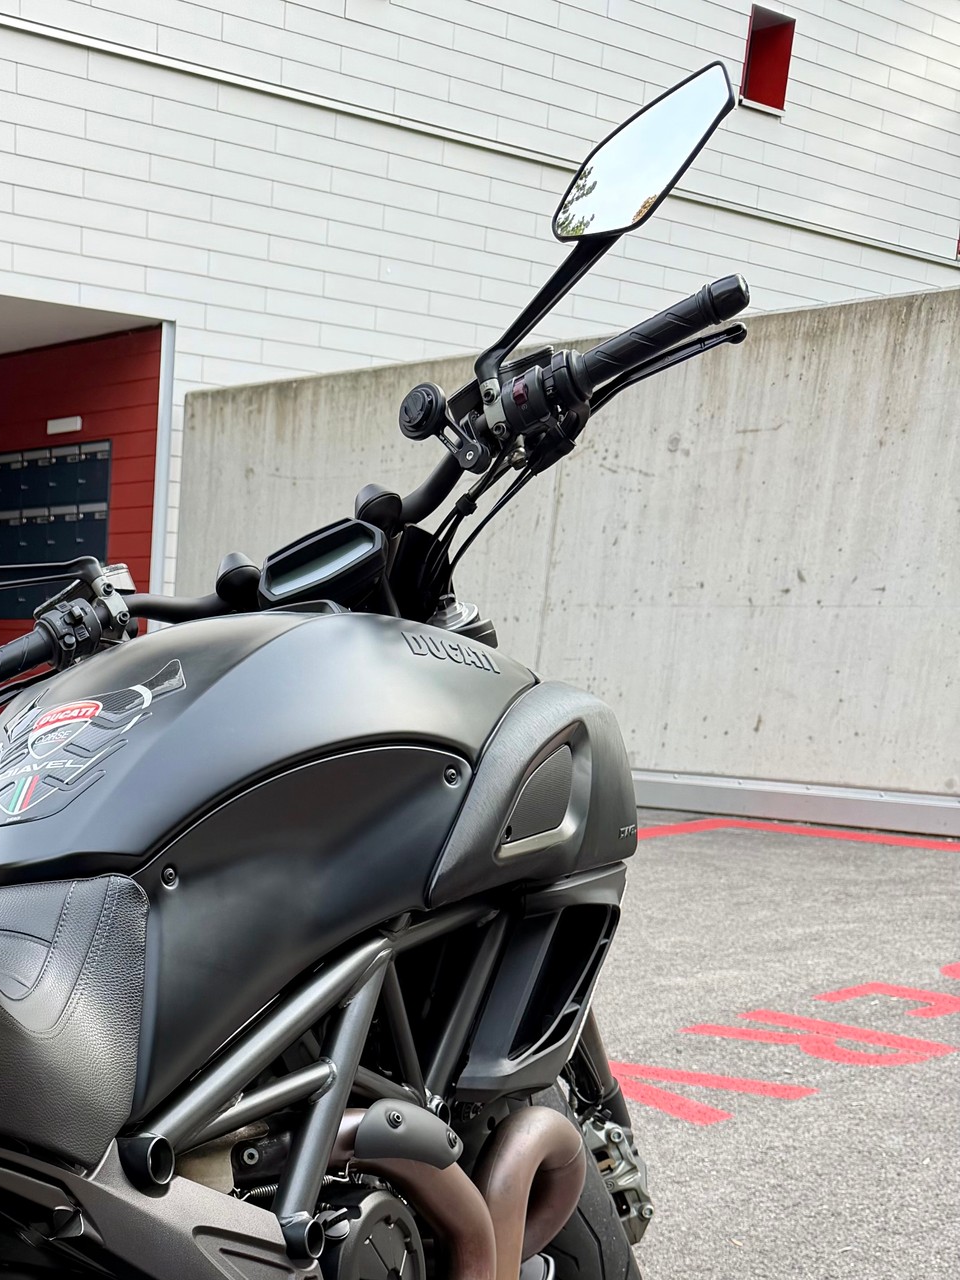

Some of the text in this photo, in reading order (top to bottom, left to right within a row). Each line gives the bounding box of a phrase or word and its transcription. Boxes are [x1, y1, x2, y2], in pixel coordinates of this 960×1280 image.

[401, 631, 500, 674] DUCATI
[40, 706, 97, 725] DUCATI
[35, 730, 72, 744] CORSE
[0, 759, 84, 780] DIAVEL
